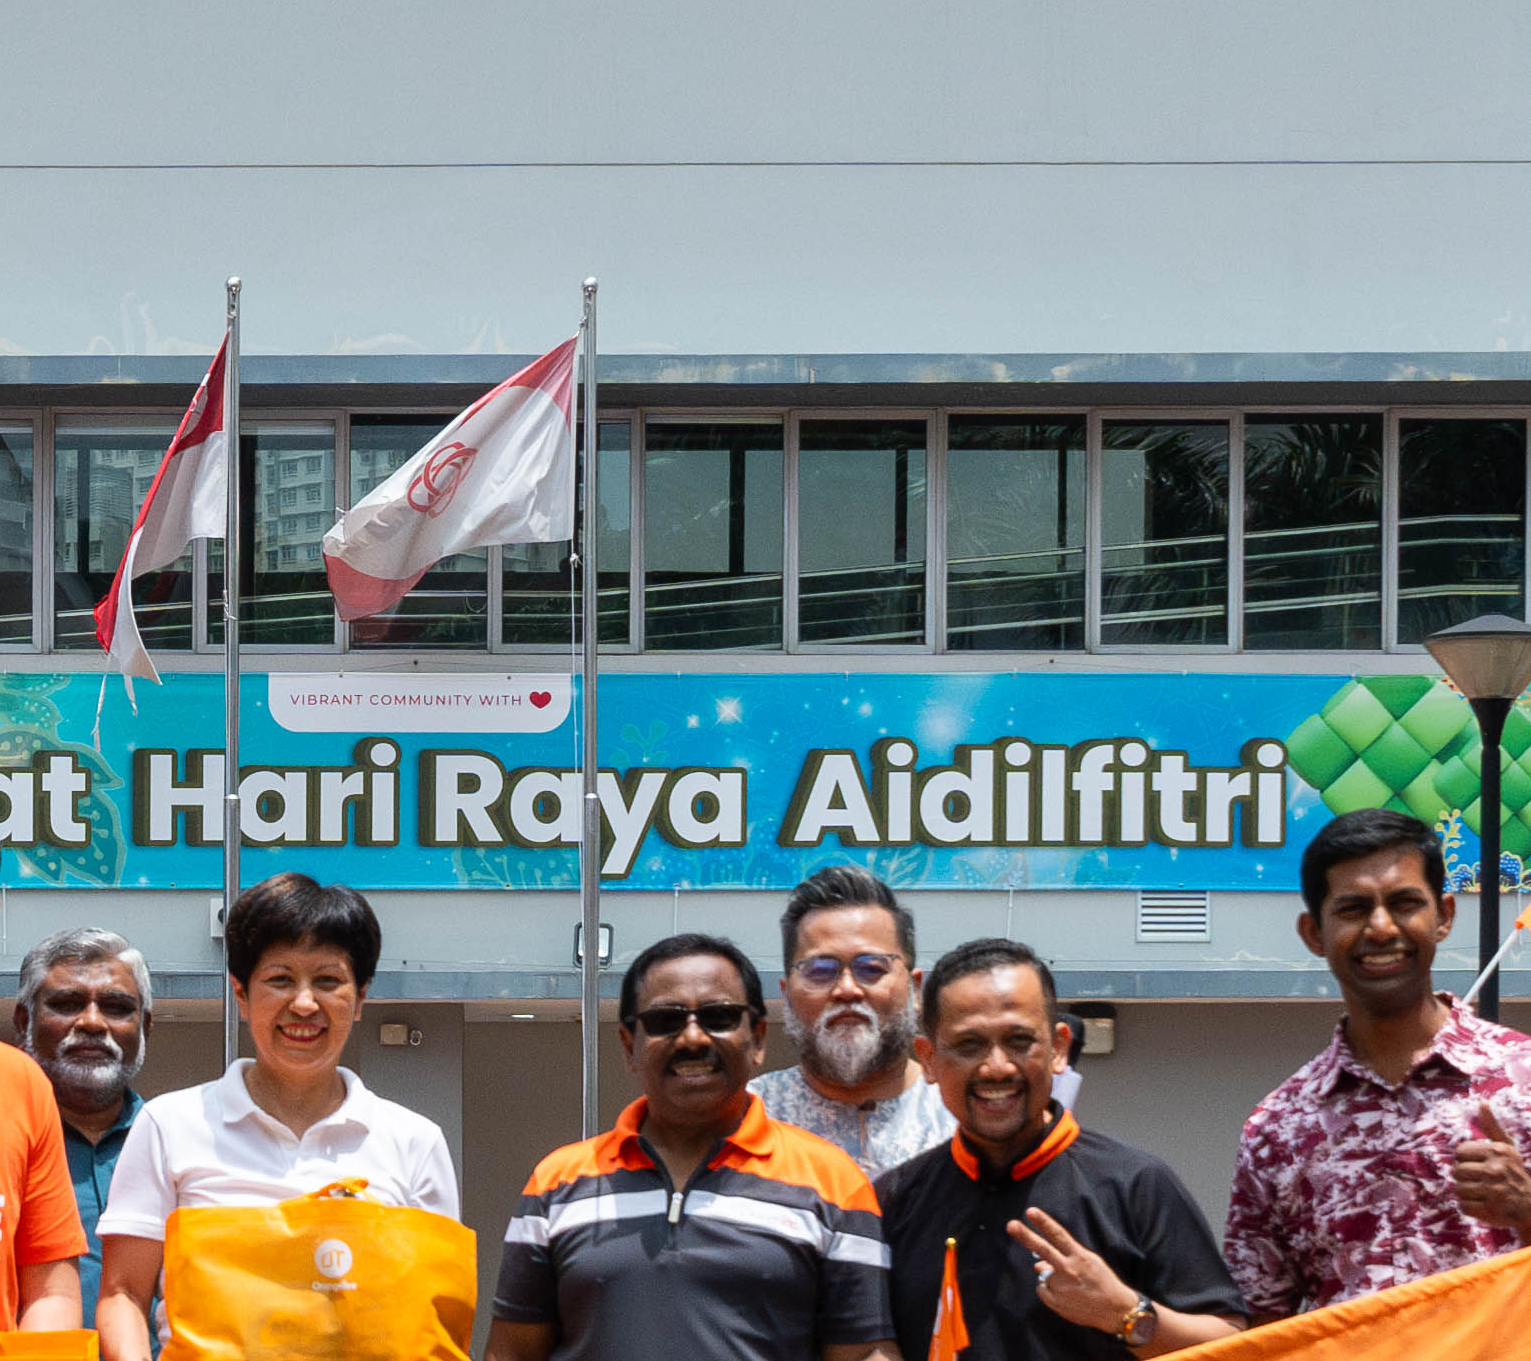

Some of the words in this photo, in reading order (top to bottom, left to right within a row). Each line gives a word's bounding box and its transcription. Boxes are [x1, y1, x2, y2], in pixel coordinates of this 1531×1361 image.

[290, 693, 363, 706] VIBRANT
[369, 693, 474, 707] COMMUNITY
[479, 694, 522, 707] WITH
[148, 741, 396, 842] Hari
[435, 753, 743, 876] Raya
[792, 740, 1287, 843] Aidilfitri
